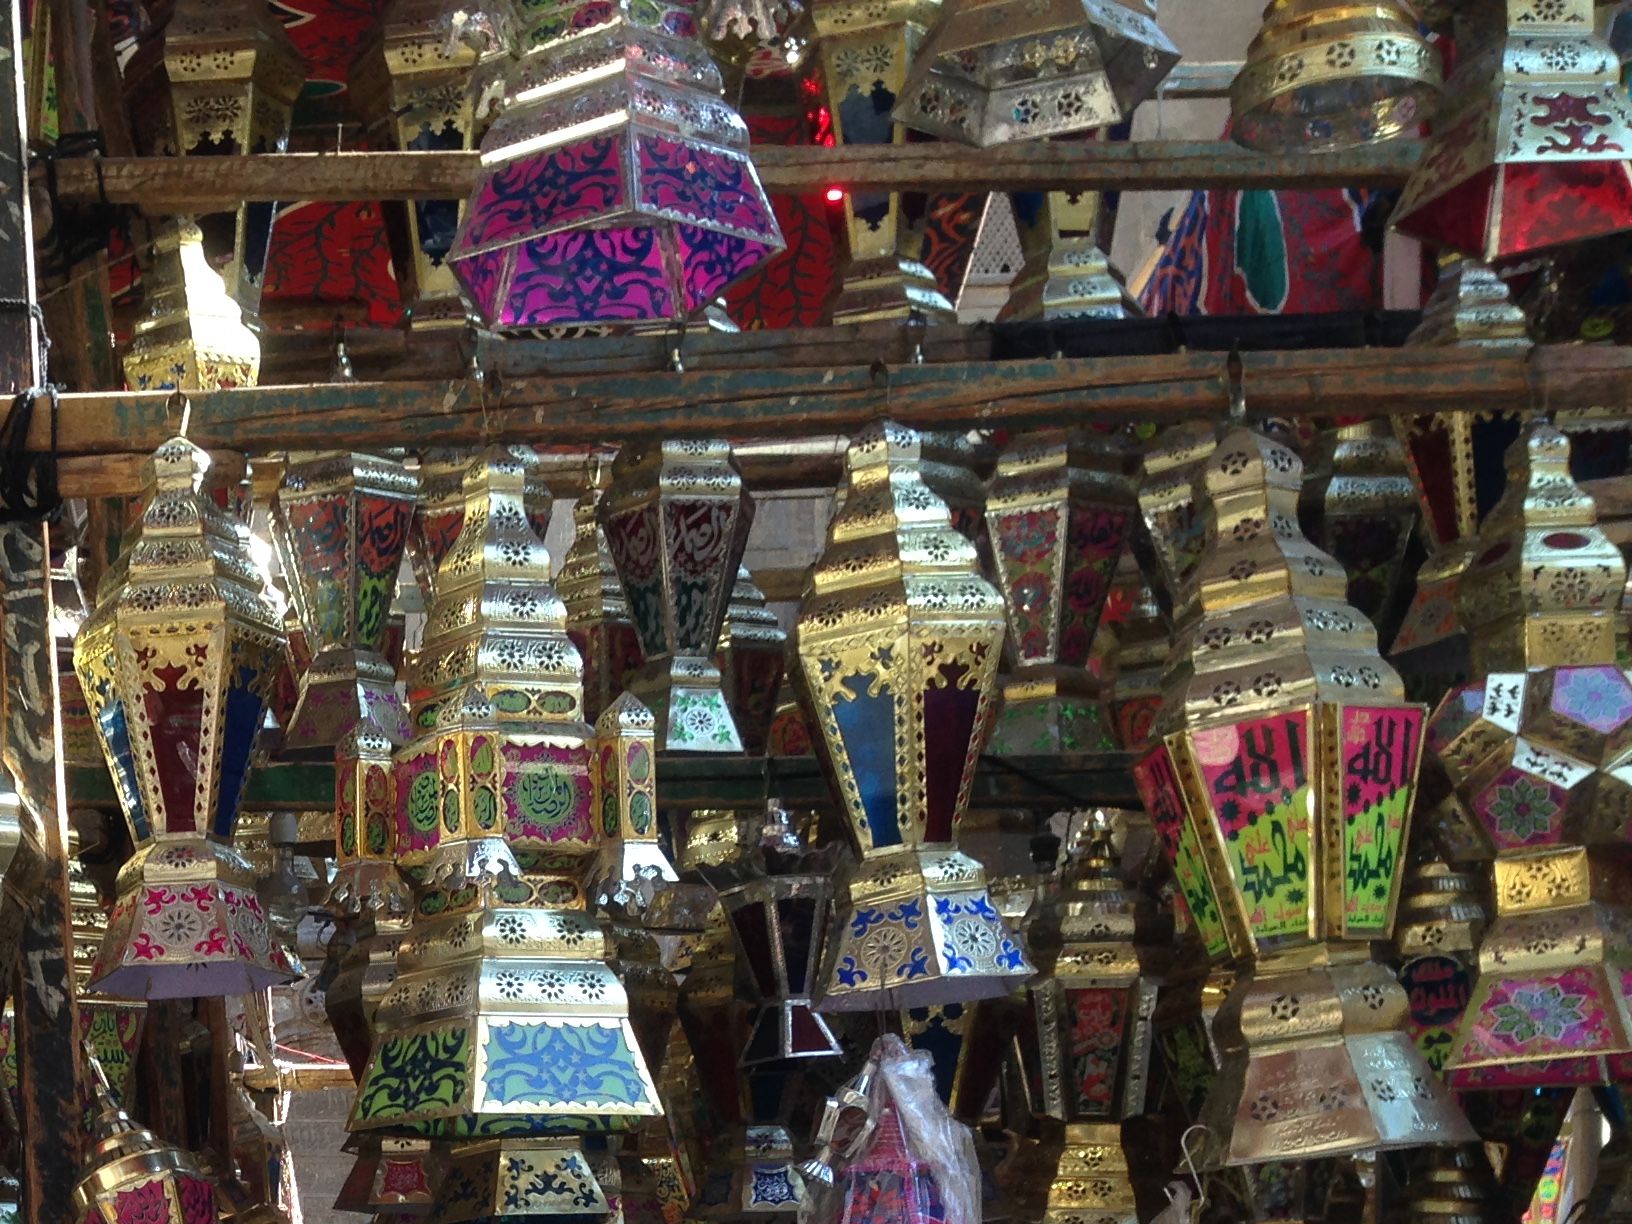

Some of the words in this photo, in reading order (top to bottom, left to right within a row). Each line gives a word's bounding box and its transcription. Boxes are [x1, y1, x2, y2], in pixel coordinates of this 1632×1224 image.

[1214, 718, 1304, 795] الله
[1347, 714, 1413, 786] الله
[1238, 818, 1306, 905] محمد
[1348, 812, 1392, 892] محمد
